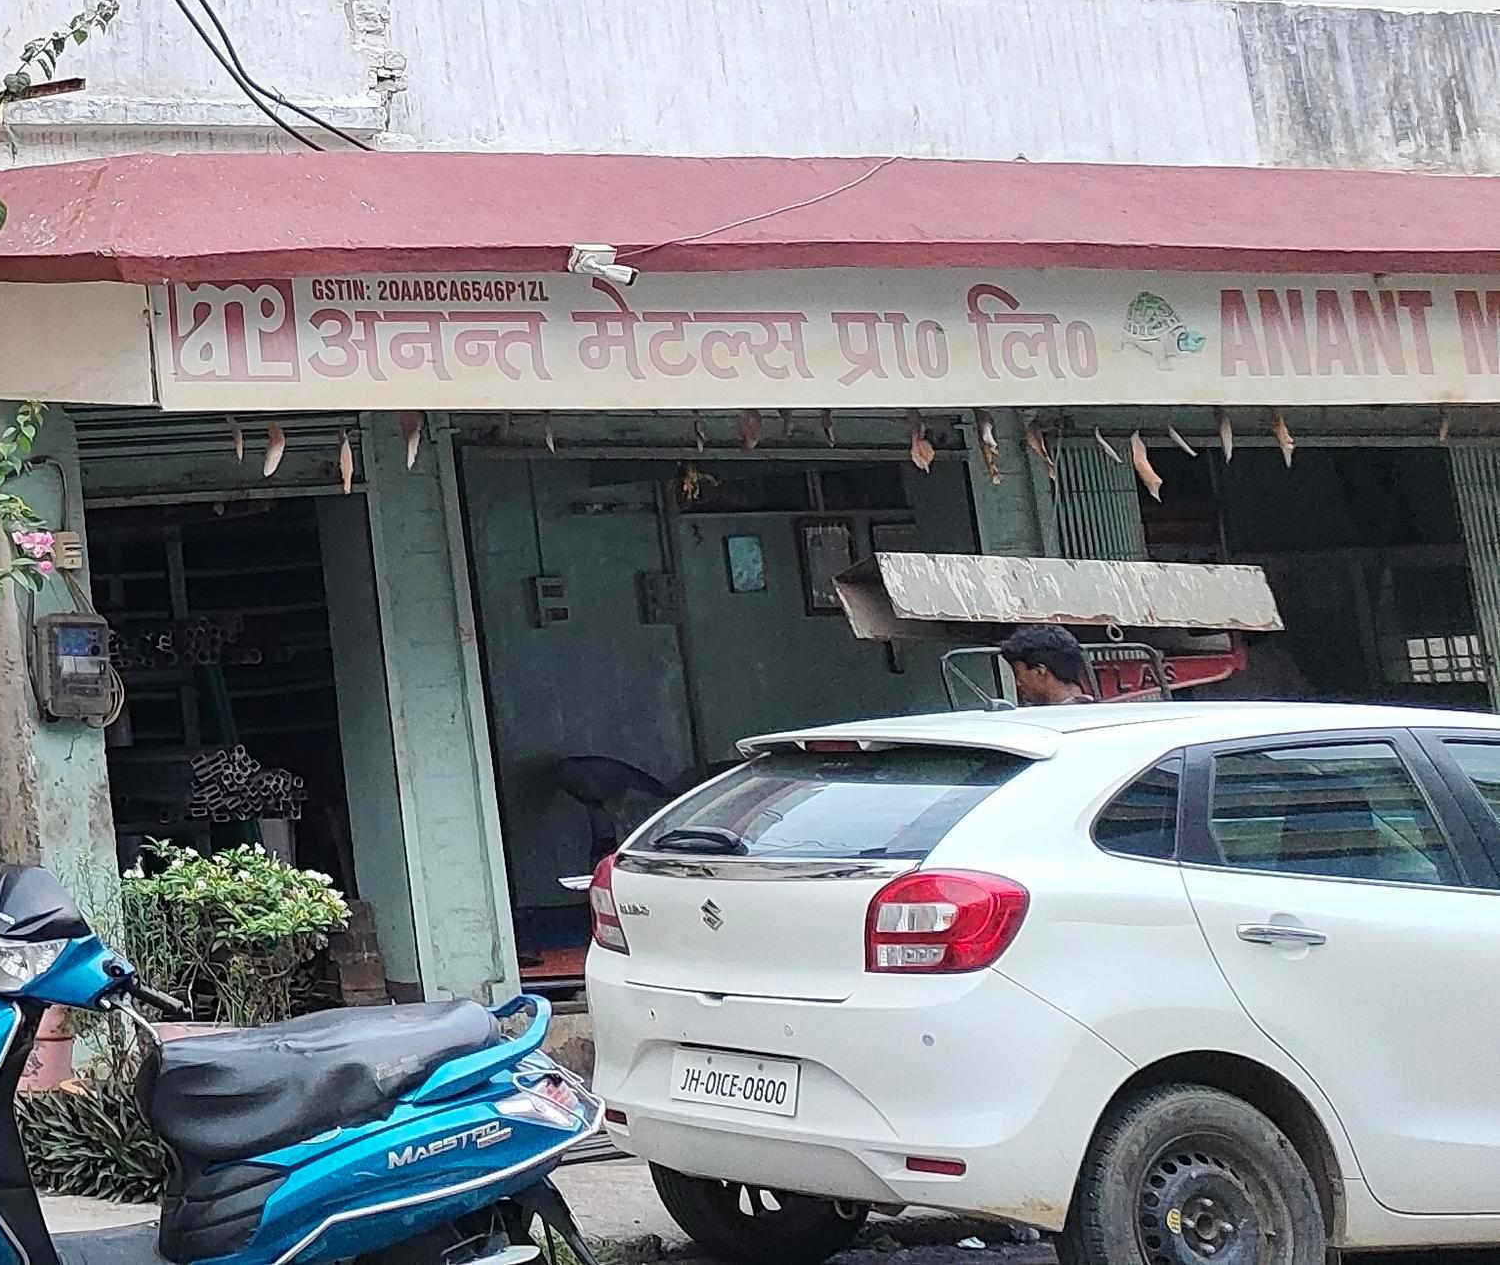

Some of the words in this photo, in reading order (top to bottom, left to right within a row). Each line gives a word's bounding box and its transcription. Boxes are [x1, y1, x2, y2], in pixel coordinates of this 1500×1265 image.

[307, 309, 554, 383] अनन्त
[571, 276, 815, 382] मेटल्स
[311, 278, 372, 302] GSTIN:
[1219, 289, 1435, 377] ANANT
